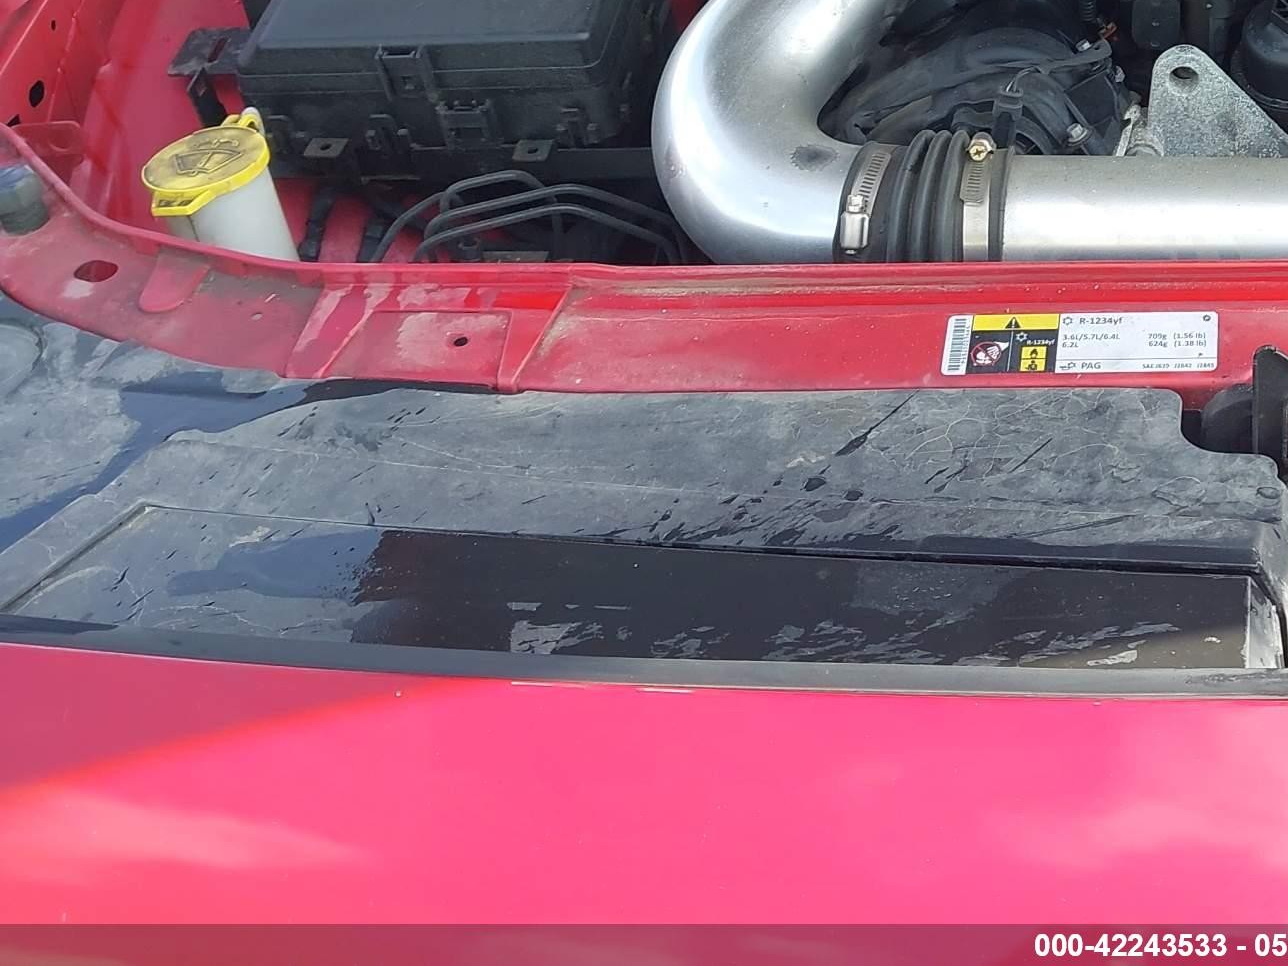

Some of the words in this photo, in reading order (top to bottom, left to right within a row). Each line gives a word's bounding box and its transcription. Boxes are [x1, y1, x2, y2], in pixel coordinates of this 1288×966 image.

[1079, 316, 1123, 327] R-1234yf
[1061, 341, 1079, 349] 6.2L
[1148, 340, 1169, 349] 624g
[1080, 361, 1102, 370] PAG
